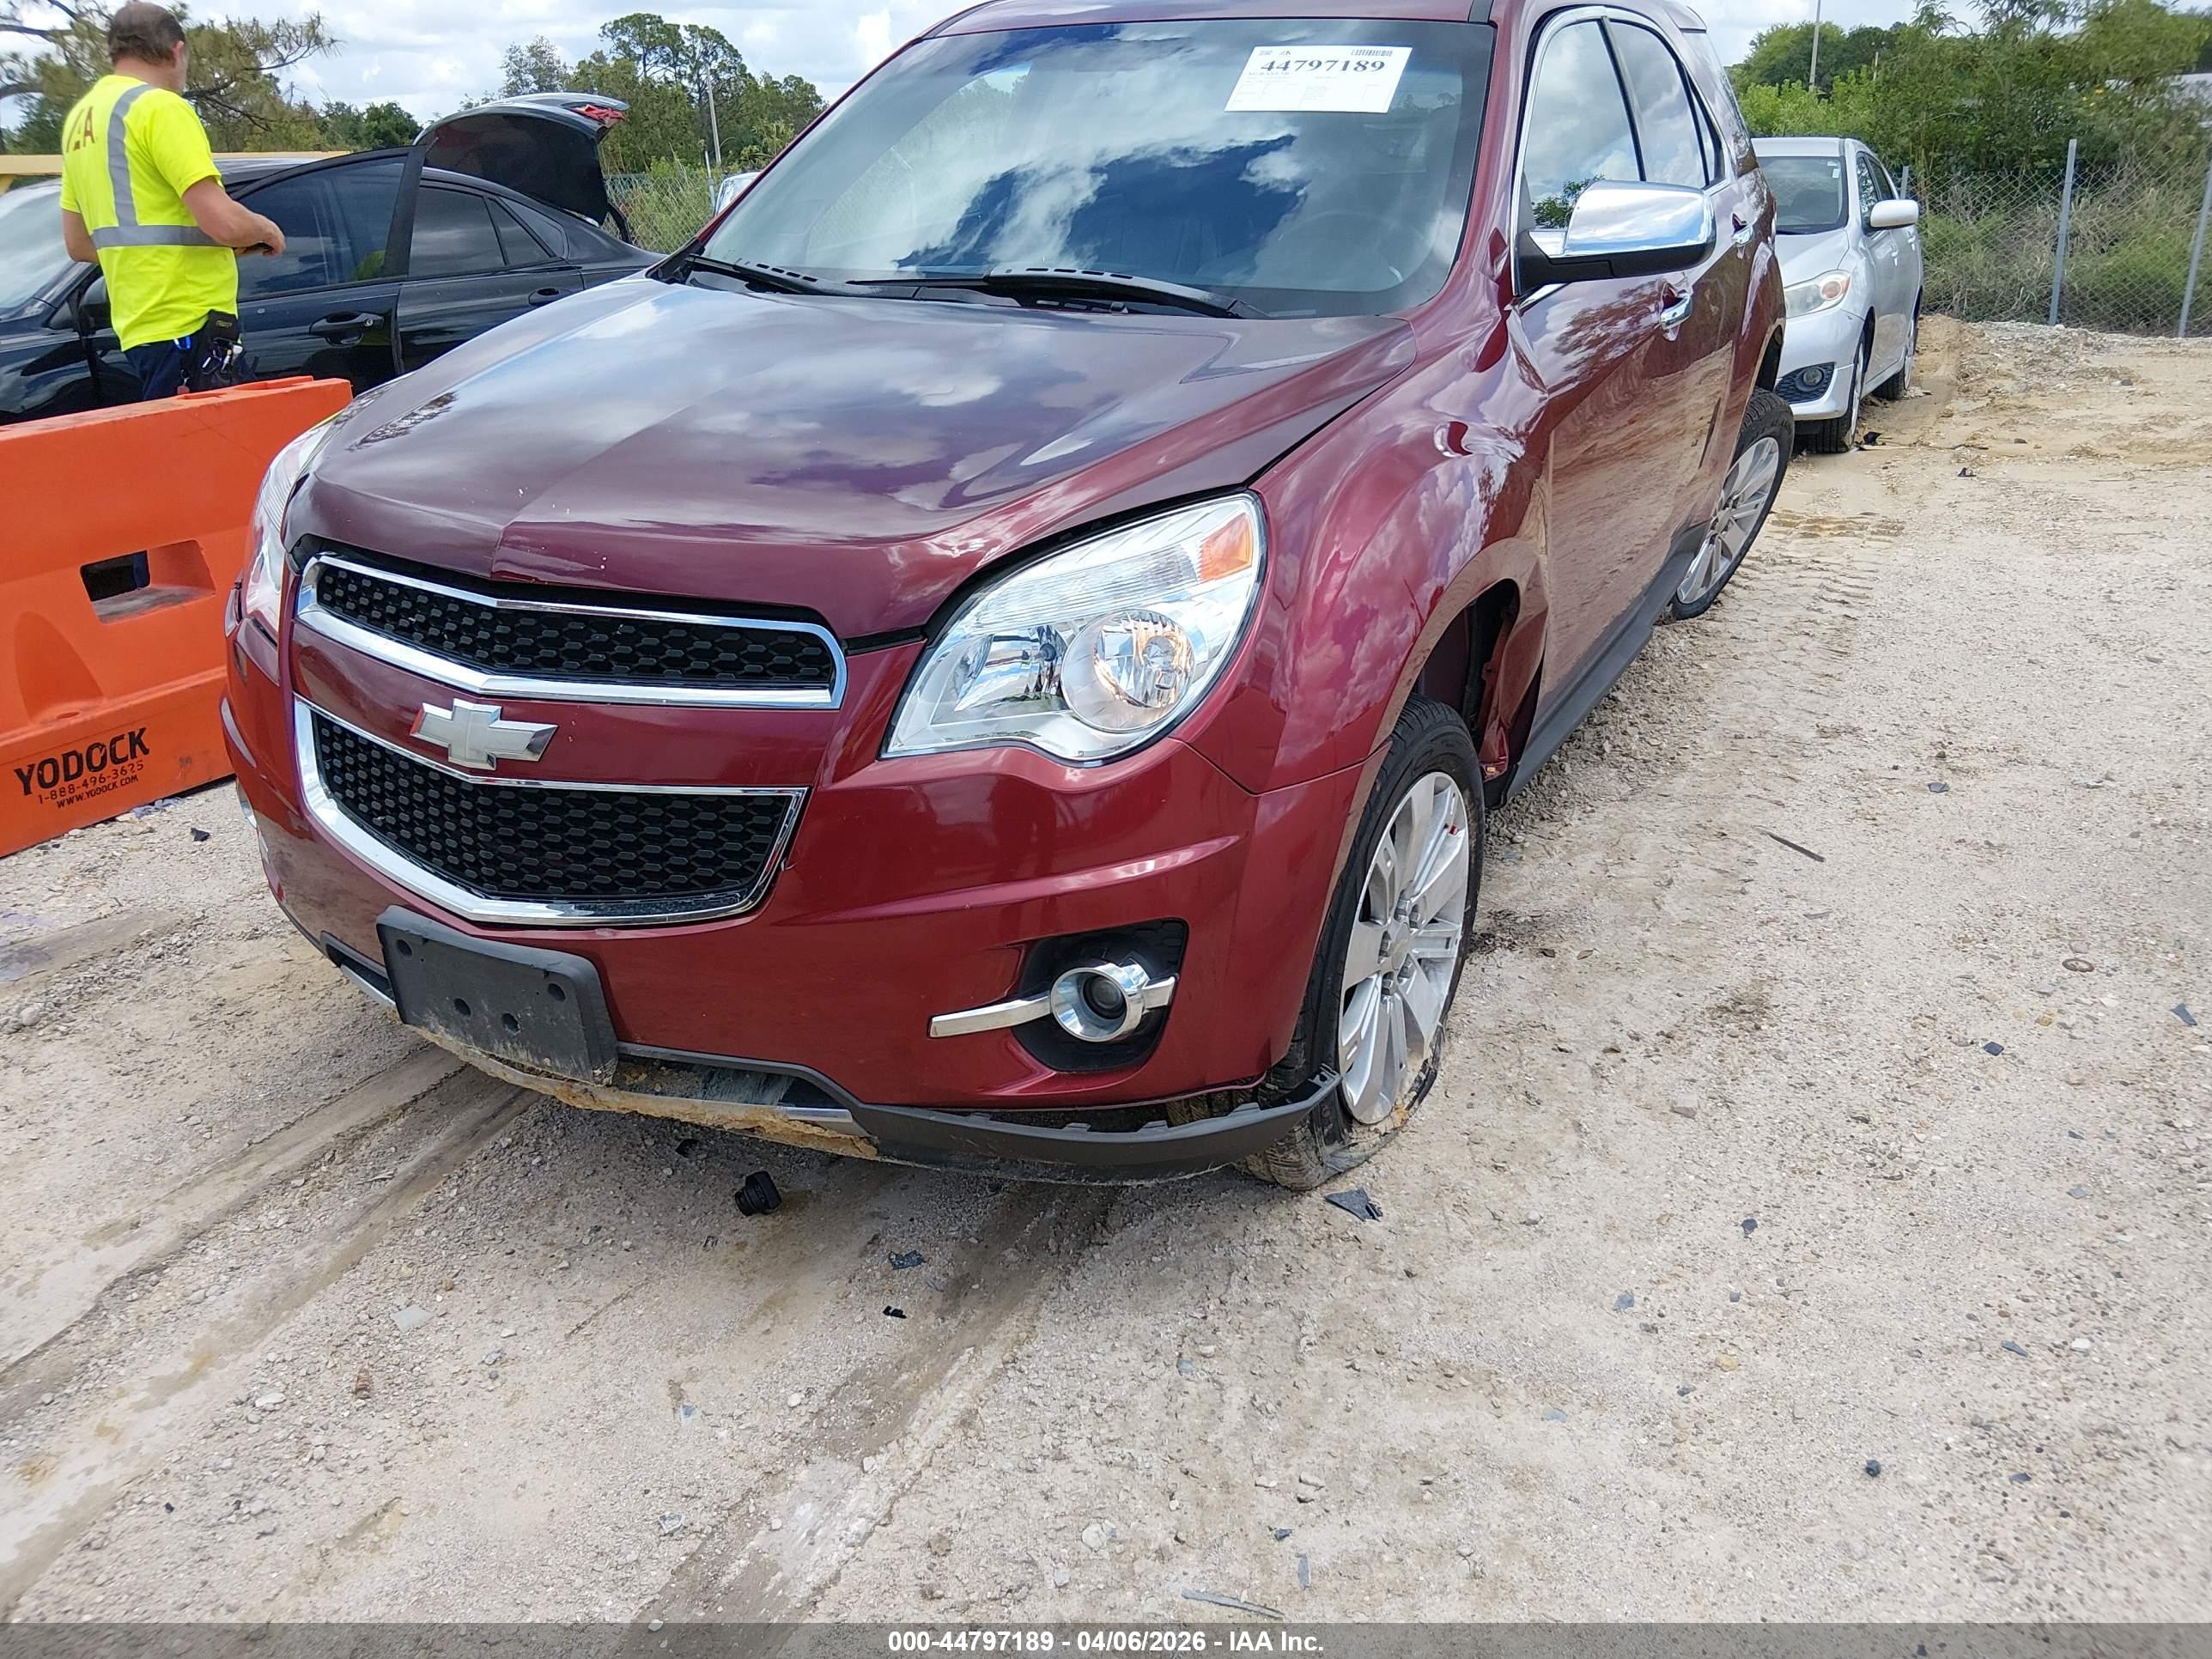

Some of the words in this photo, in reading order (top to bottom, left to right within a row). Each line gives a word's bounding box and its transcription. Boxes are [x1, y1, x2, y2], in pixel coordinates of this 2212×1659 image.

[1260, 59, 1386, 73] 44797189
[14, 727, 150, 796] YODOCK
[38, 760, 144, 805] 1-888-496-3625
[56, 775, 139, 809] WWW.YODOCKCOM
